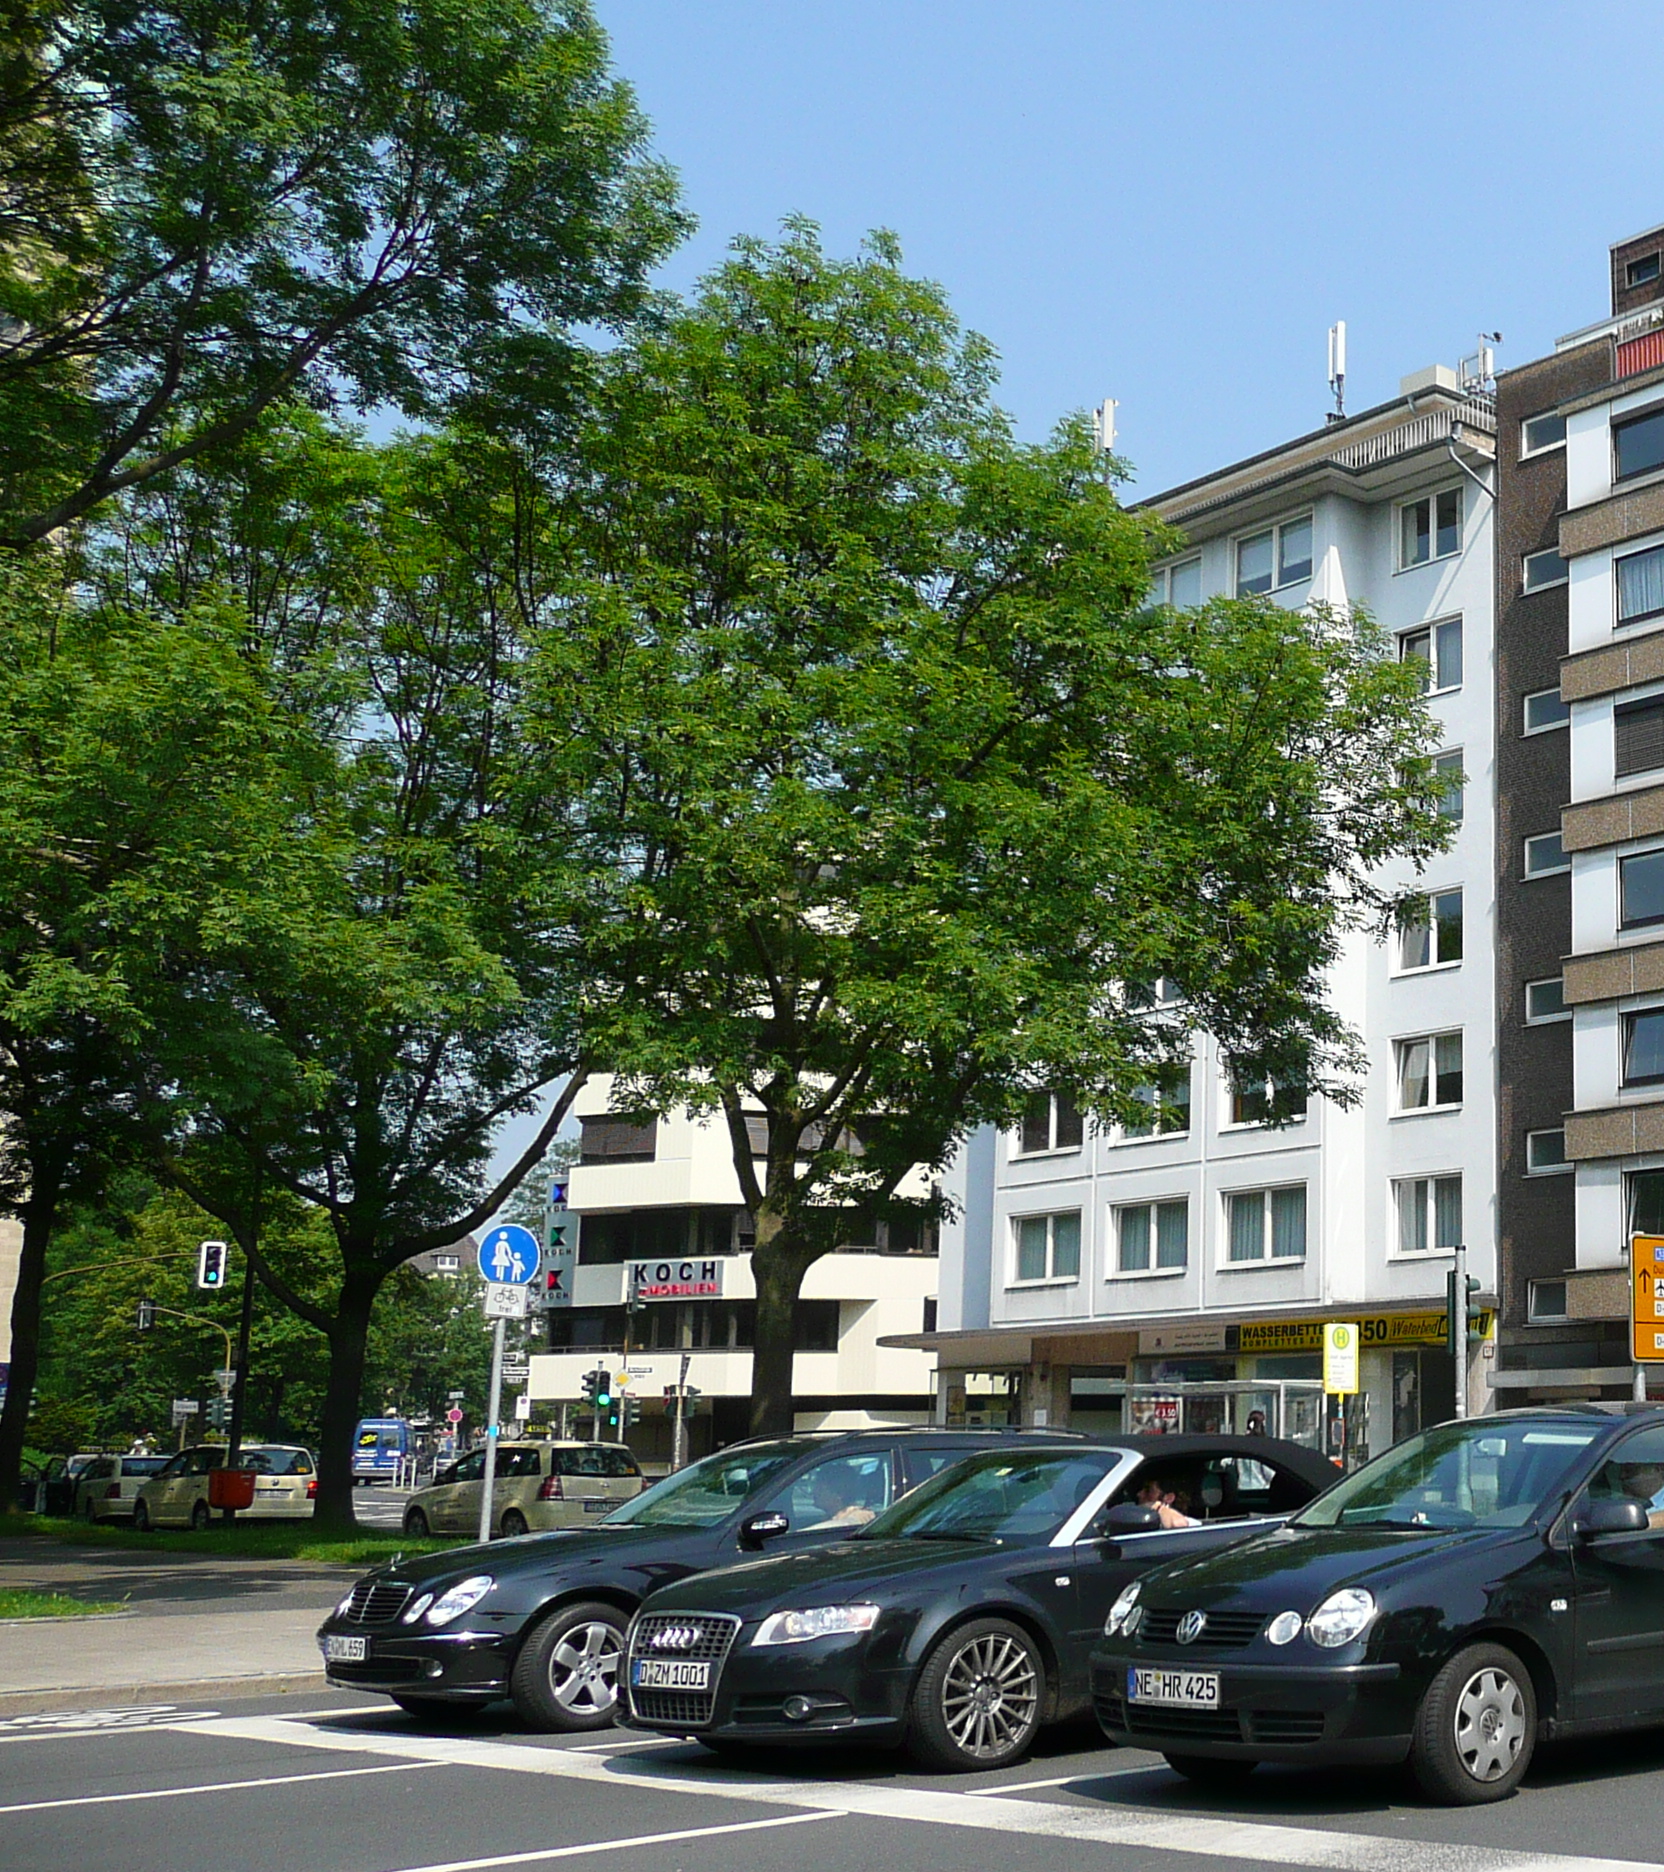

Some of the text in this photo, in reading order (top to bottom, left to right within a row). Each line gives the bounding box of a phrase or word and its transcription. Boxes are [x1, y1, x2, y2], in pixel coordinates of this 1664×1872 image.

[545, 1248, 572, 1256] KOCH
[633, 1261, 716, 1283] KOCH
[542, 1291, 569, 1299] KOCH
[499, 1305, 512, 1313] frei
[1242, 1322, 1325, 1339] WASSERBETTE
[1392, 1319, 1439, 1336] Waterbed
[1242, 1337, 1305, 1347] KOMPLETTES
[1336, 1331, 1346, 1344] H
[348, 1639, 364, 1658] 659
[640, 1662, 706, 1686] D ZM 1001
[1135, 1672, 1216, 1700] NE HR 425
